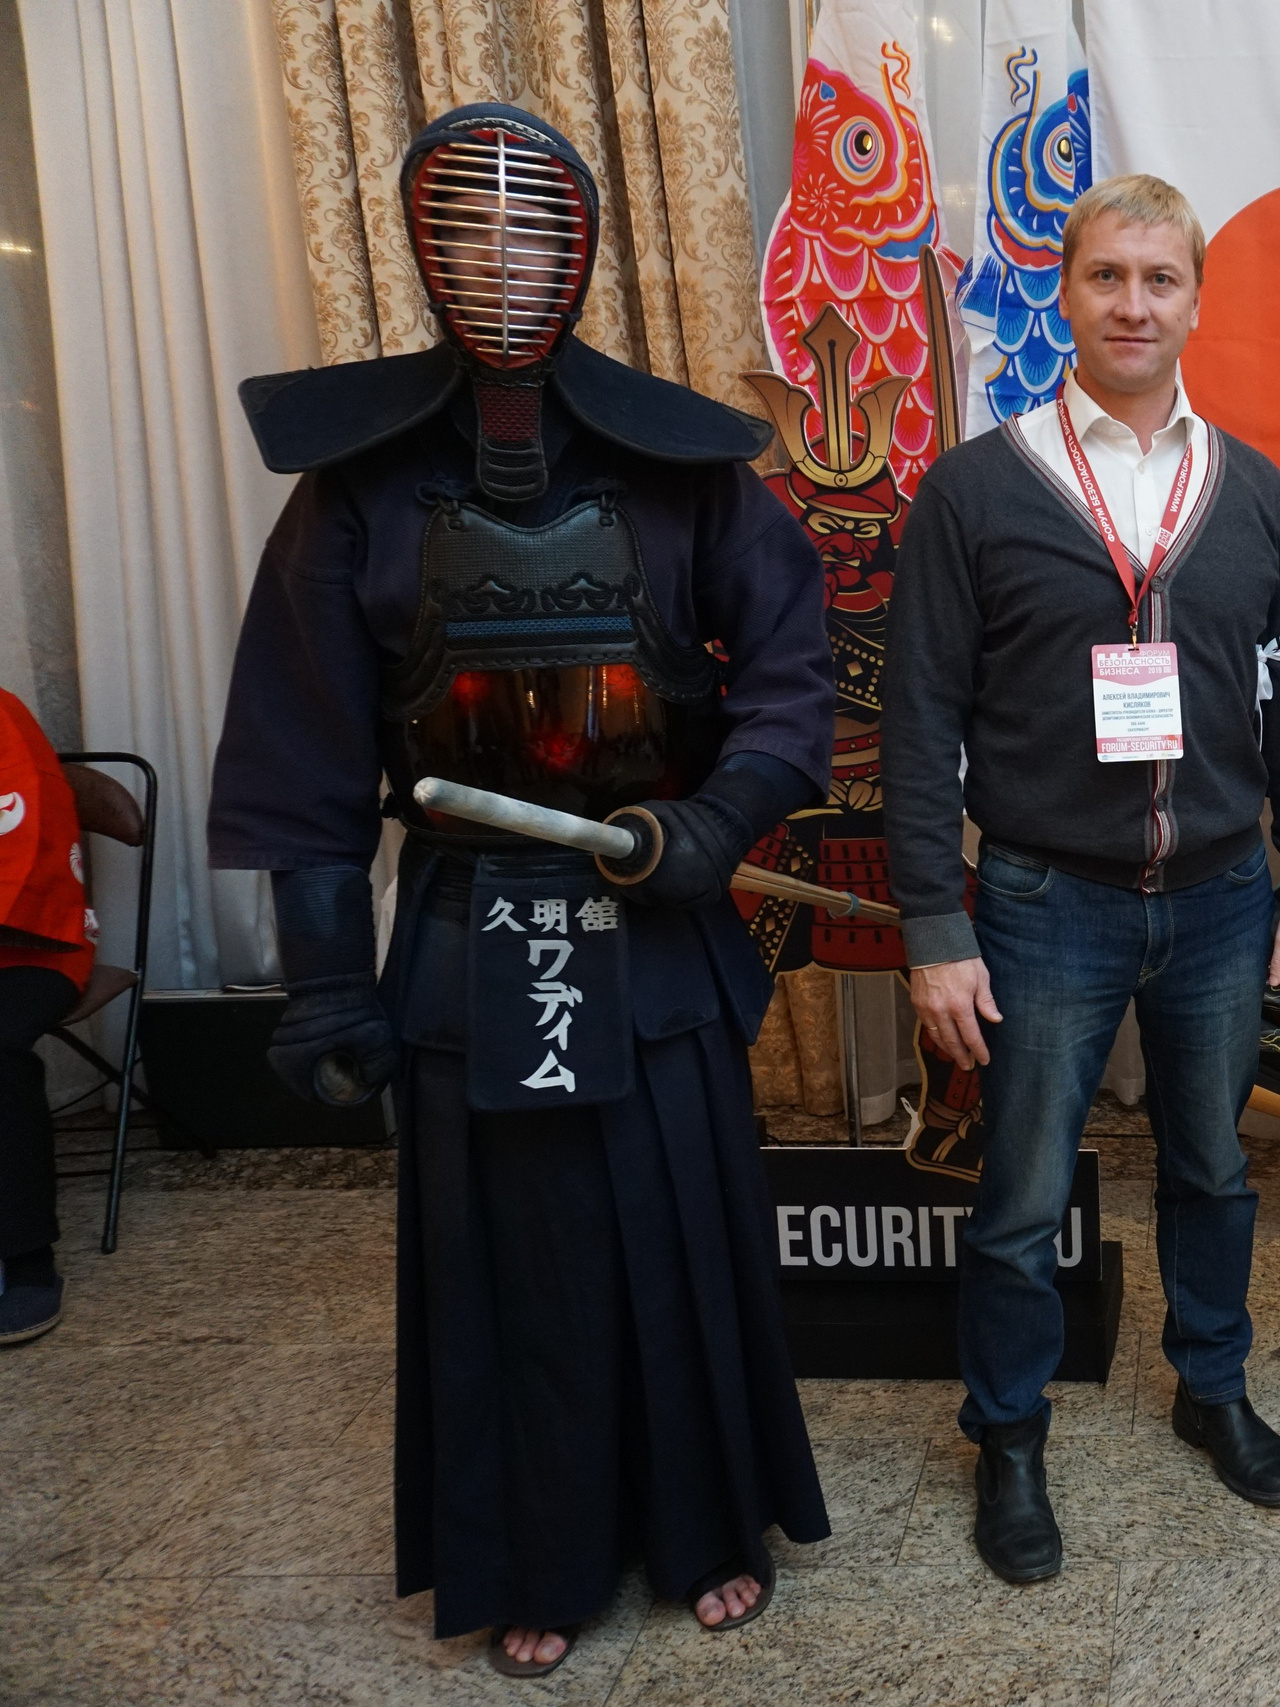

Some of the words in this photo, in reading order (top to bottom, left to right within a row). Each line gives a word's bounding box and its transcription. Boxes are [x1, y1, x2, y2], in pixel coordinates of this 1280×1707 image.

[1068, 435, 1101, 507] БЕЗОПАСНОСТЬ
[1095, 507, 1115, 542] ФОРУМ
[1099, 657, 1170, 667] БЕЗОПАСНОСТЬ
[1099, 667, 1140, 676] БИЗНЕСА
[1102, 692, 1127, 701] АЛЕКСЕЙ
[1127, 691, 1171, 700] ВЛАДИМИРОВИЧ
[1123, 701, 1151, 709] КИСЛЯКОВ
[1101, 740, 1178, 753] FORUM-SECURITY.RU
[519, 939, 583, 1093] ワディム
